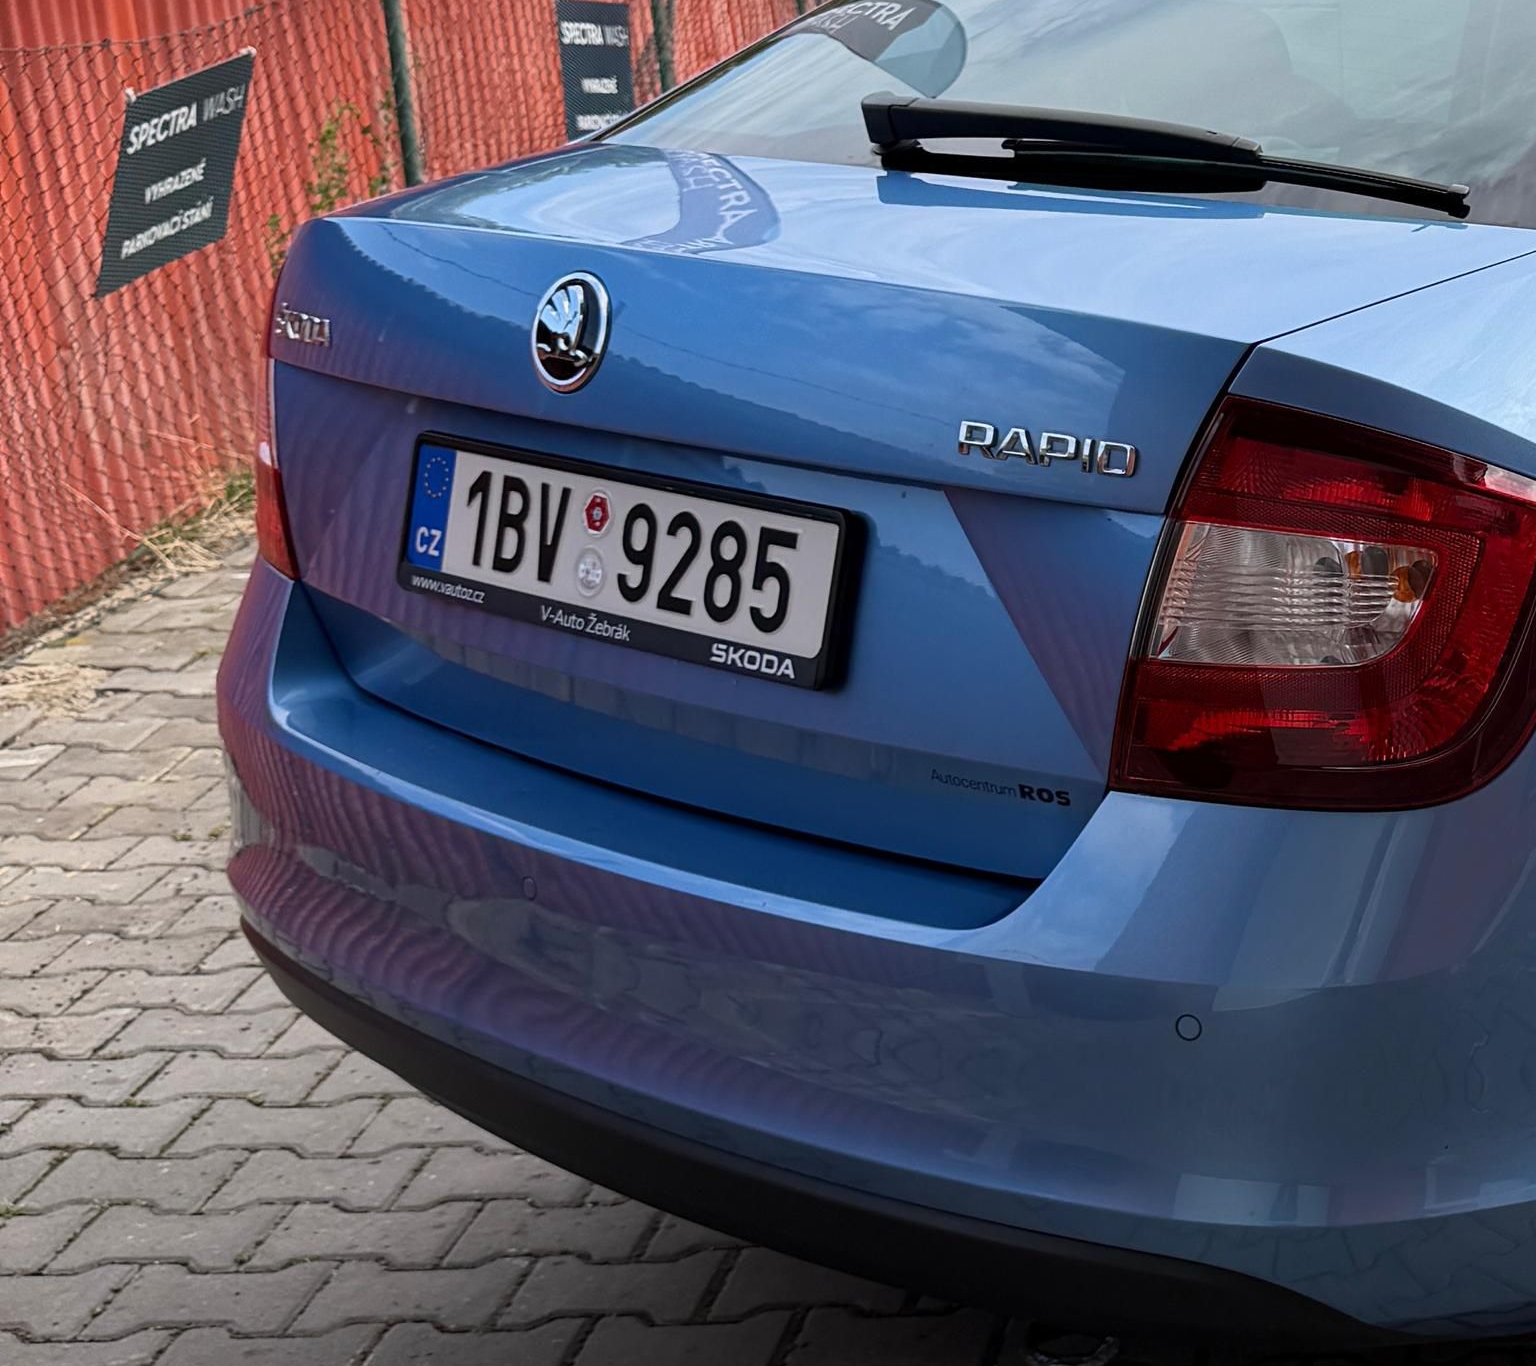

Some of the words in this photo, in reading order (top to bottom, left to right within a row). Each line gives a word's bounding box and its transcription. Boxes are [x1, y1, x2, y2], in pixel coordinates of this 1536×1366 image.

[126, 101, 197, 156] SPECTRA
[203, 83, 246, 123] WASH
[958, 420, 1137, 478] RAPID
[415, 526, 442, 557] CZ
[466, 470, 572, 584] 1BV
[617, 503, 799, 633] 9285
[540, 605, 585, 632] V-Auto
[585, 612, 632, 641] Žebrák
[930, 768, 1018, 797] Autocentrum
[1018, 783, 1072, 807] ROS
